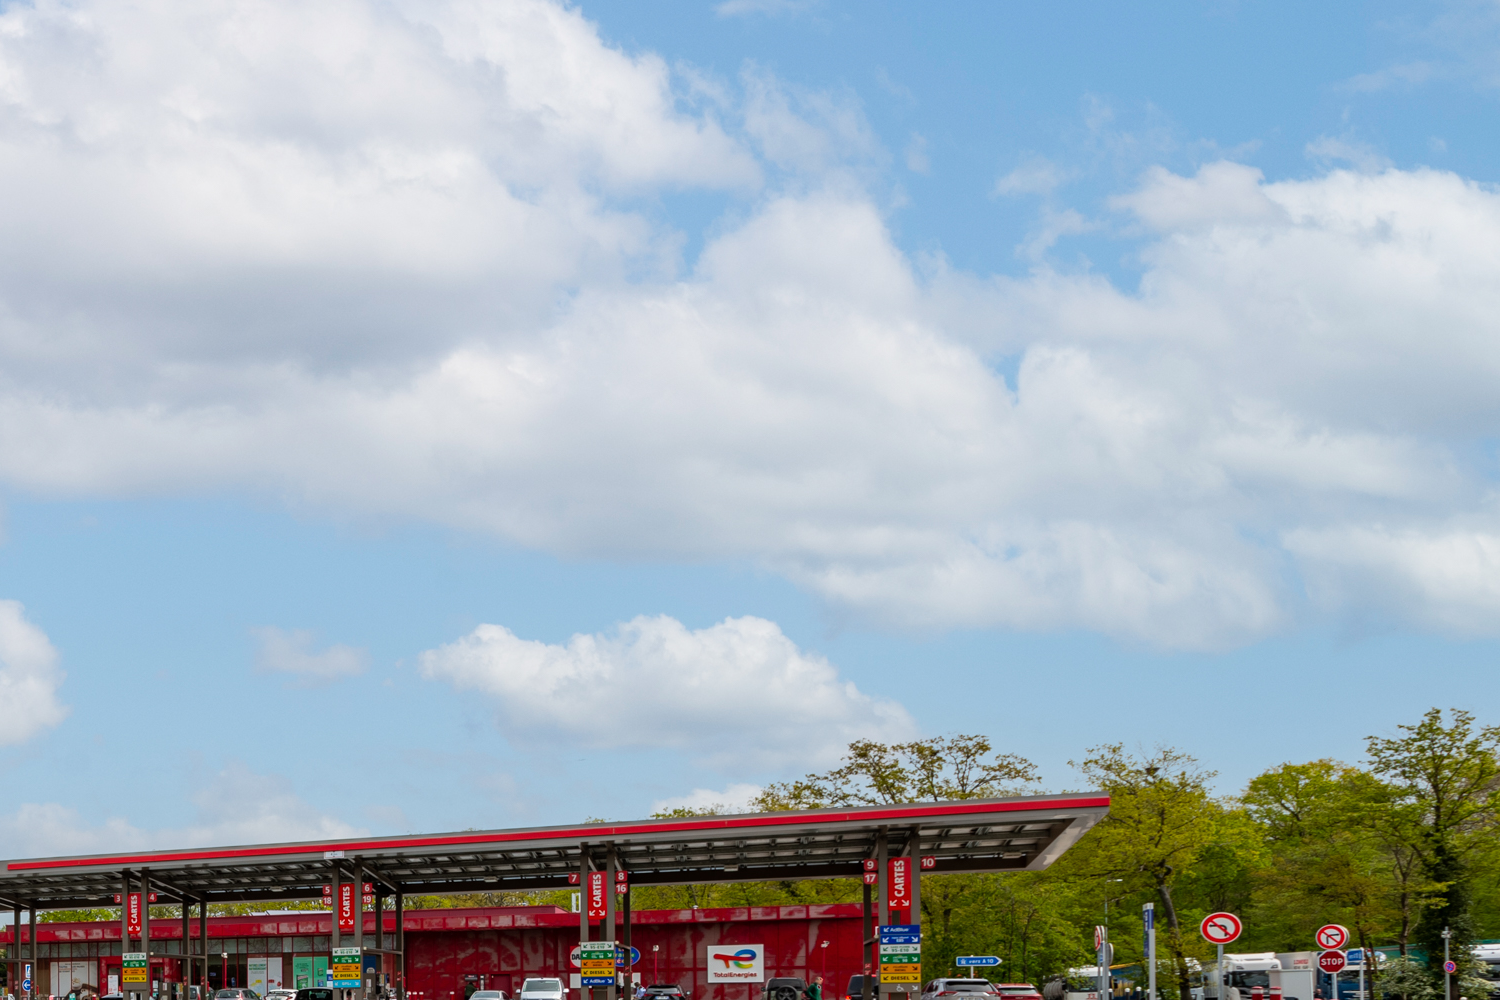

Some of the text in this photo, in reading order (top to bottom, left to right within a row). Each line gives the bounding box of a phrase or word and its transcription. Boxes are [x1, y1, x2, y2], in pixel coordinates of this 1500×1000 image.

[867, 861, 874, 869] 9
[922, 858, 934, 867] 10
[571, 874, 577, 882] 7
[618, 872, 624, 880] 8
[865, 874, 876, 882] 17
[894, 860, 905, 897] CARTES
[325, 886, 330, 894] 5
[364, 884, 370, 892] 6
[593, 874, 602, 907] CARTES
[616, 884, 626, 892] 16
[323, 897, 332, 905] 18
[342, 886, 350, 917] CARTES
[363, 895, 372, 903] 19
[1321, 958, 1343, 966] STOP
